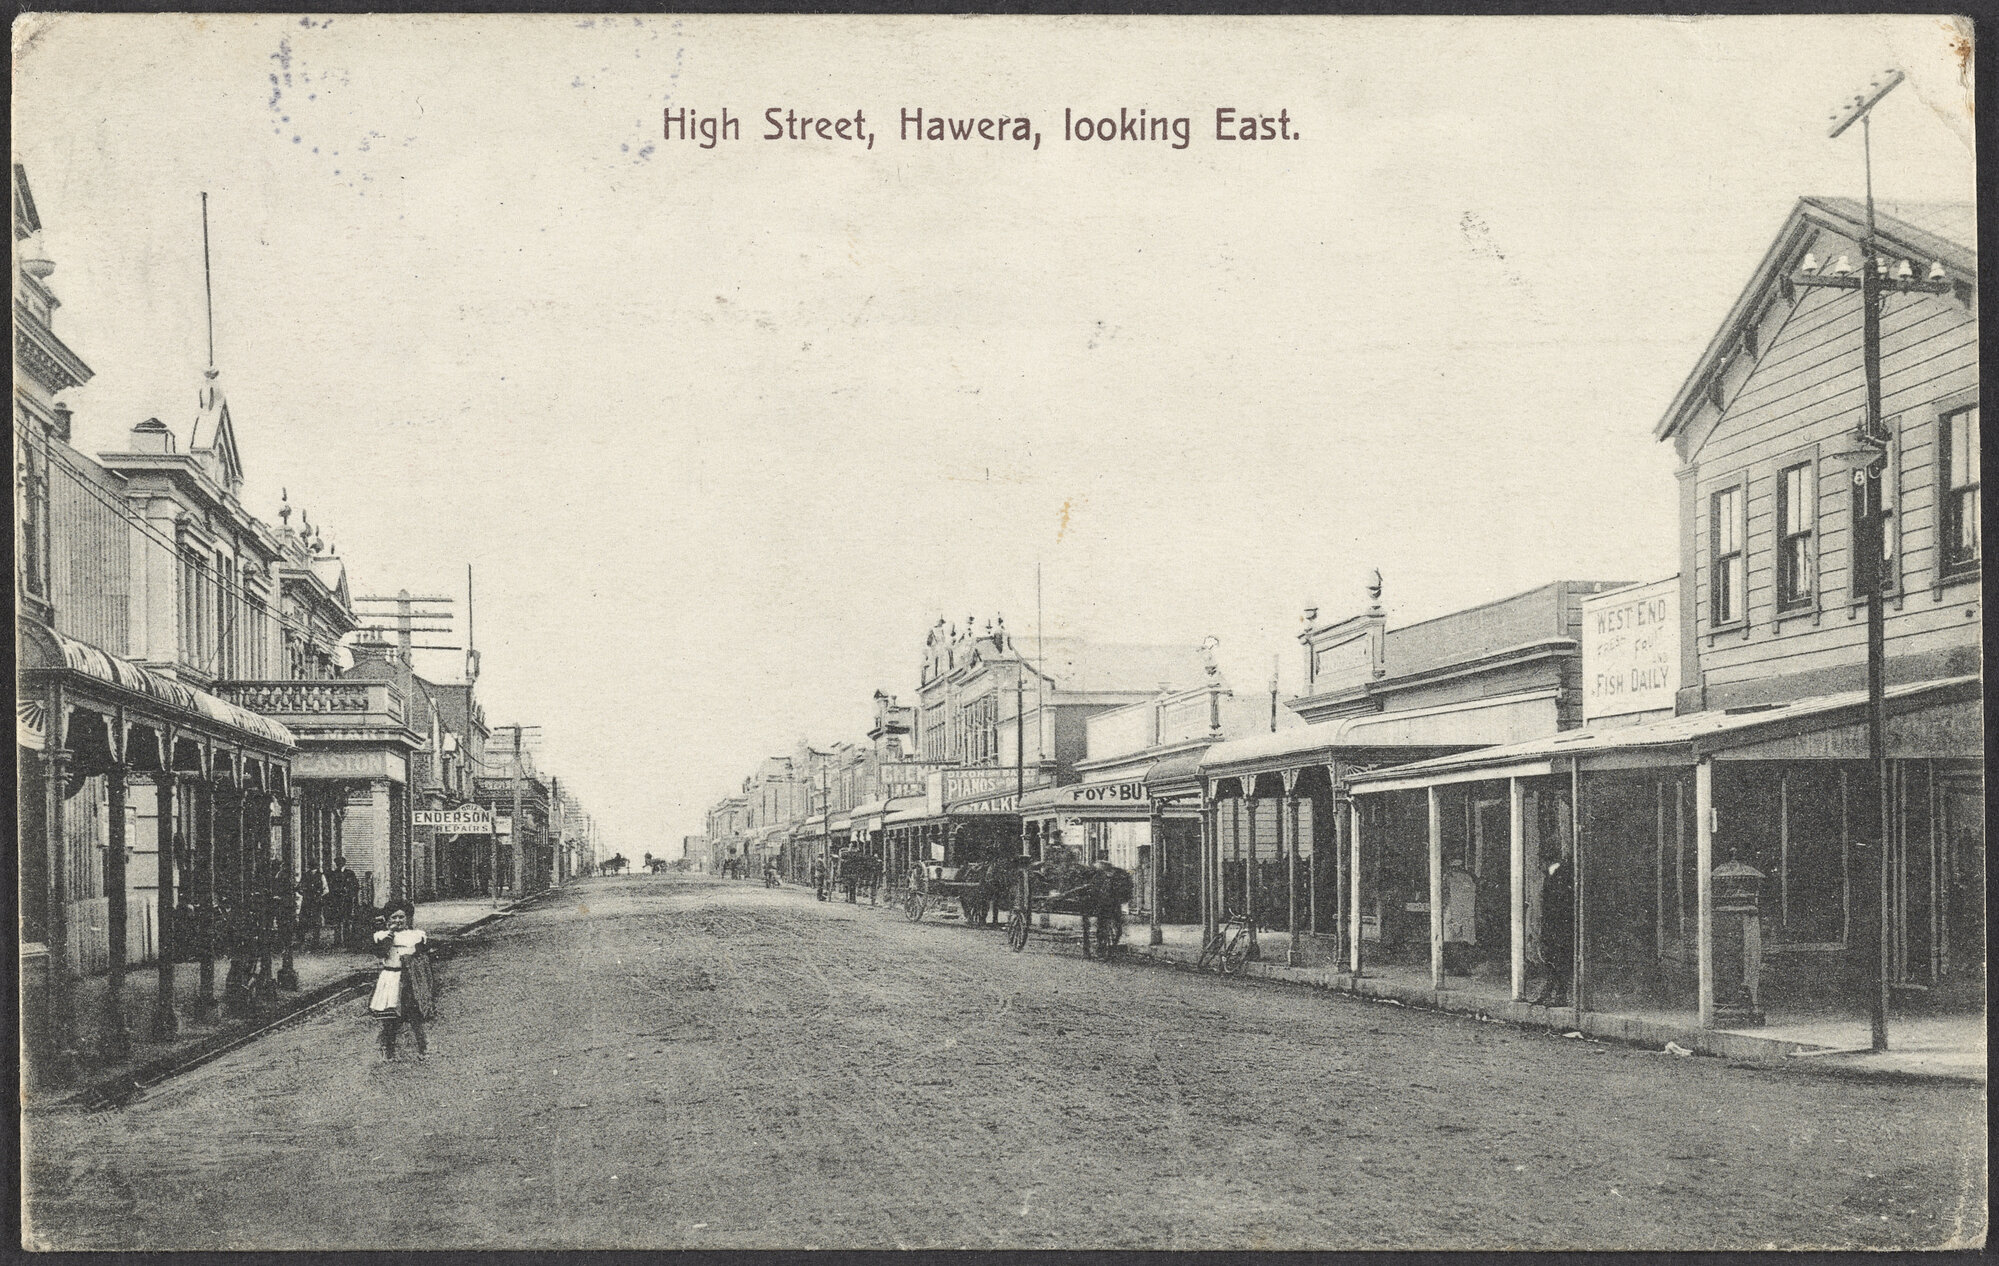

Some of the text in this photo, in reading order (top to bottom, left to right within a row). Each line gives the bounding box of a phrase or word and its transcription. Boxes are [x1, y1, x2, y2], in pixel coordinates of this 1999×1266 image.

[1597, 599, 1666, 634] WEST END
[1597, 665, 1669, 697] FISH DAILY
[948, 778, 996, 799] PIANOS
[1074, 784, 1117, 801] FOY'S
[436, 824, 489, 833] REPAIRS
